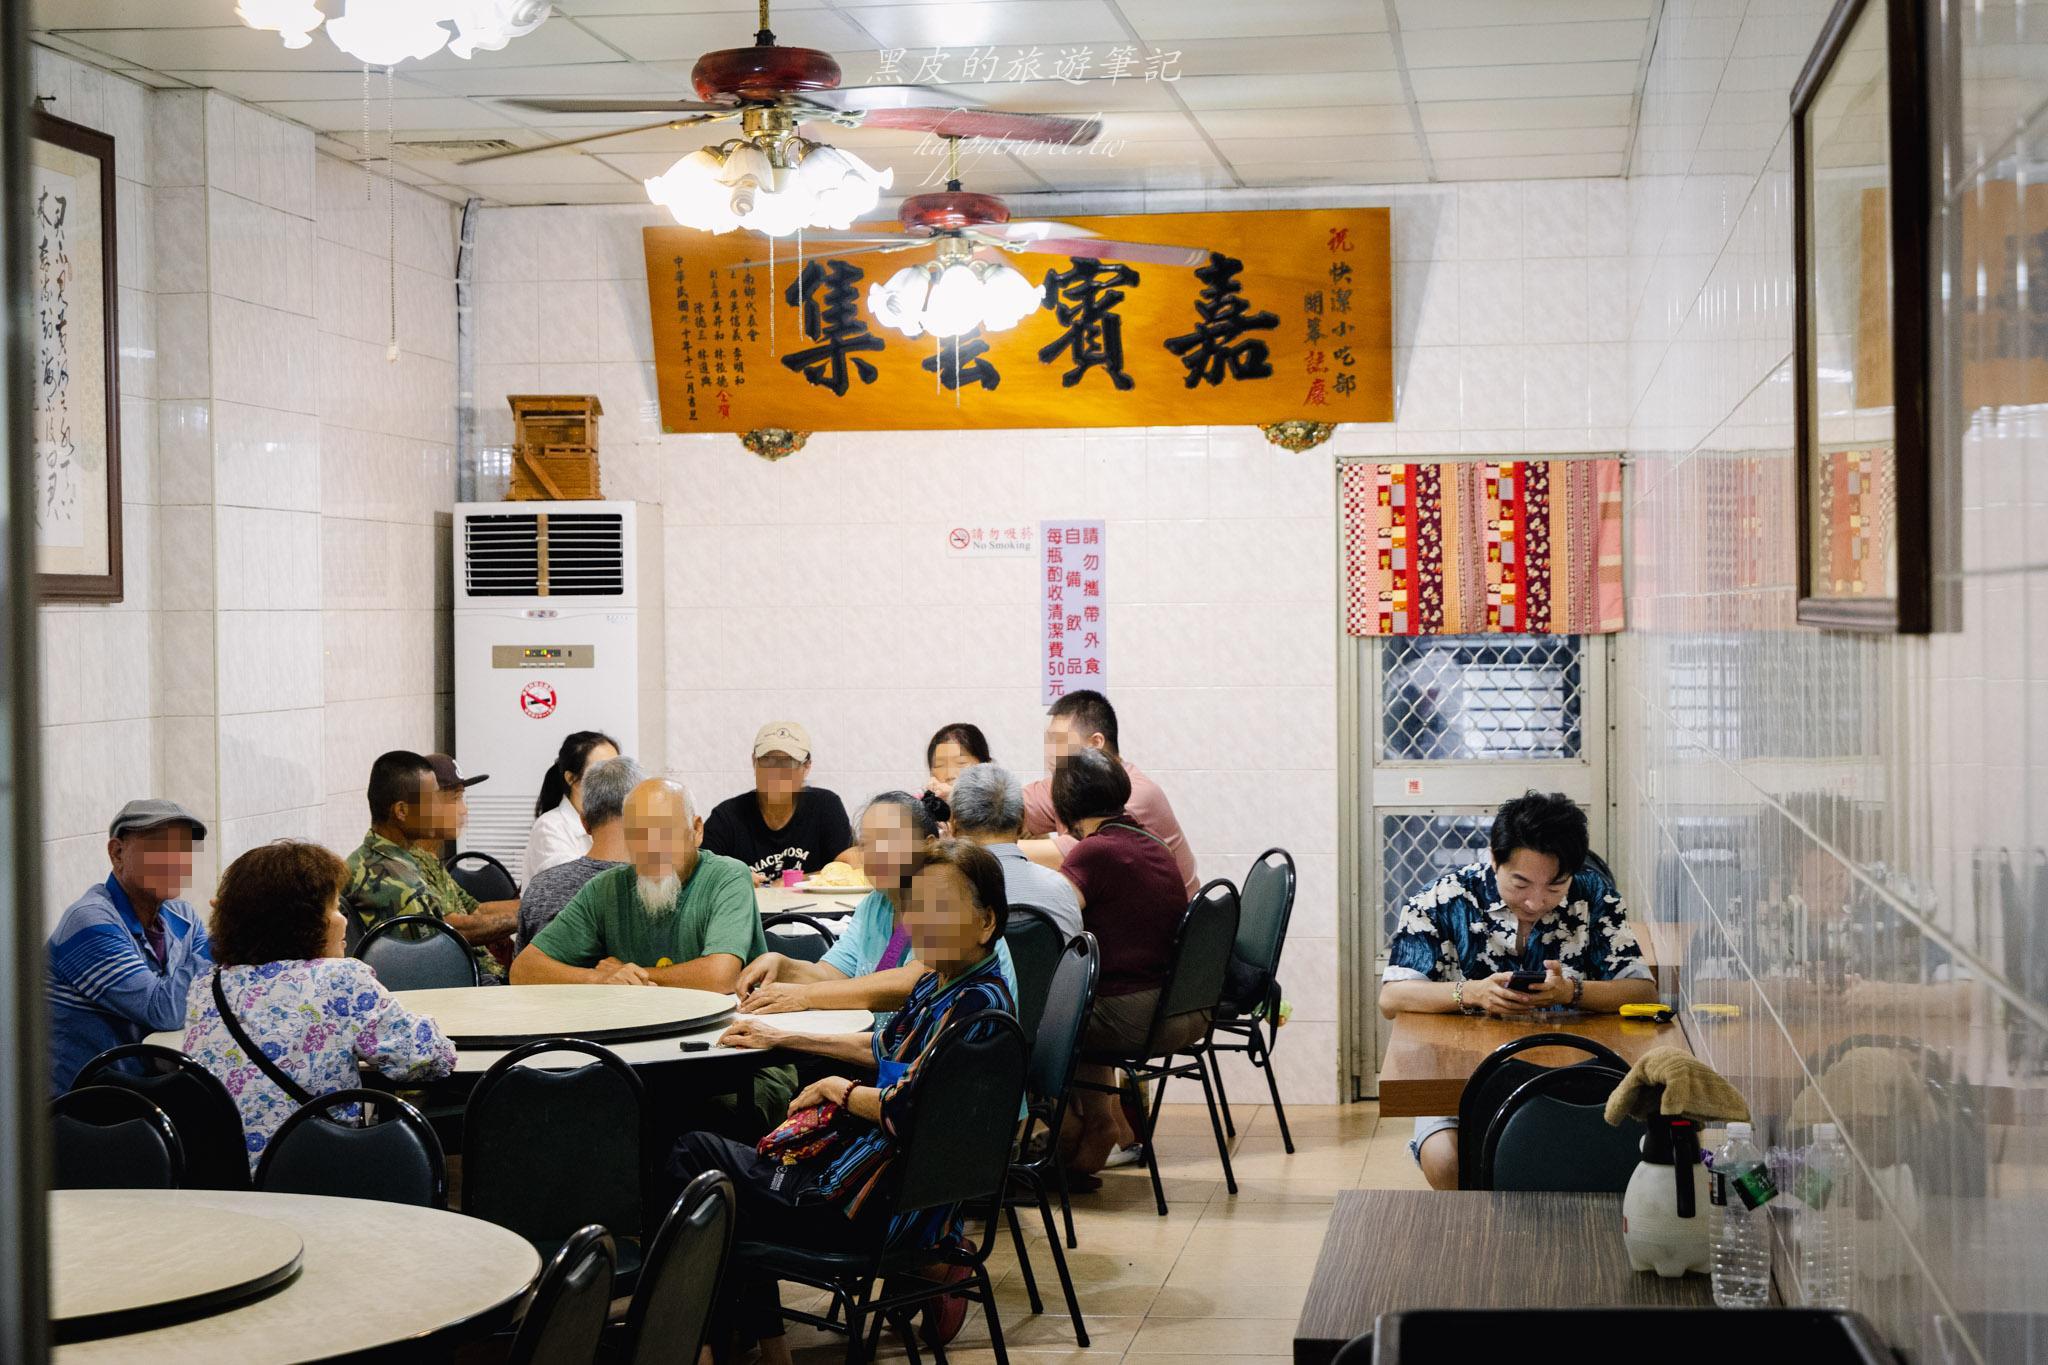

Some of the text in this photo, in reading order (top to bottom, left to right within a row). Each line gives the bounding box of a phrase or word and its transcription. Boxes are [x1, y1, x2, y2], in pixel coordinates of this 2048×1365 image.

[1327, 227, 1357, 397] 祝快潔小吃部
[973, 541, 1031, 551] No Smoking
[1047, 528, 1065, 696] 每瓶酌收清潔費50元
[1065, 528, 1082, 674] 自備飲品
[1083, 527, 1101, 674] 請勿攜帶外食
